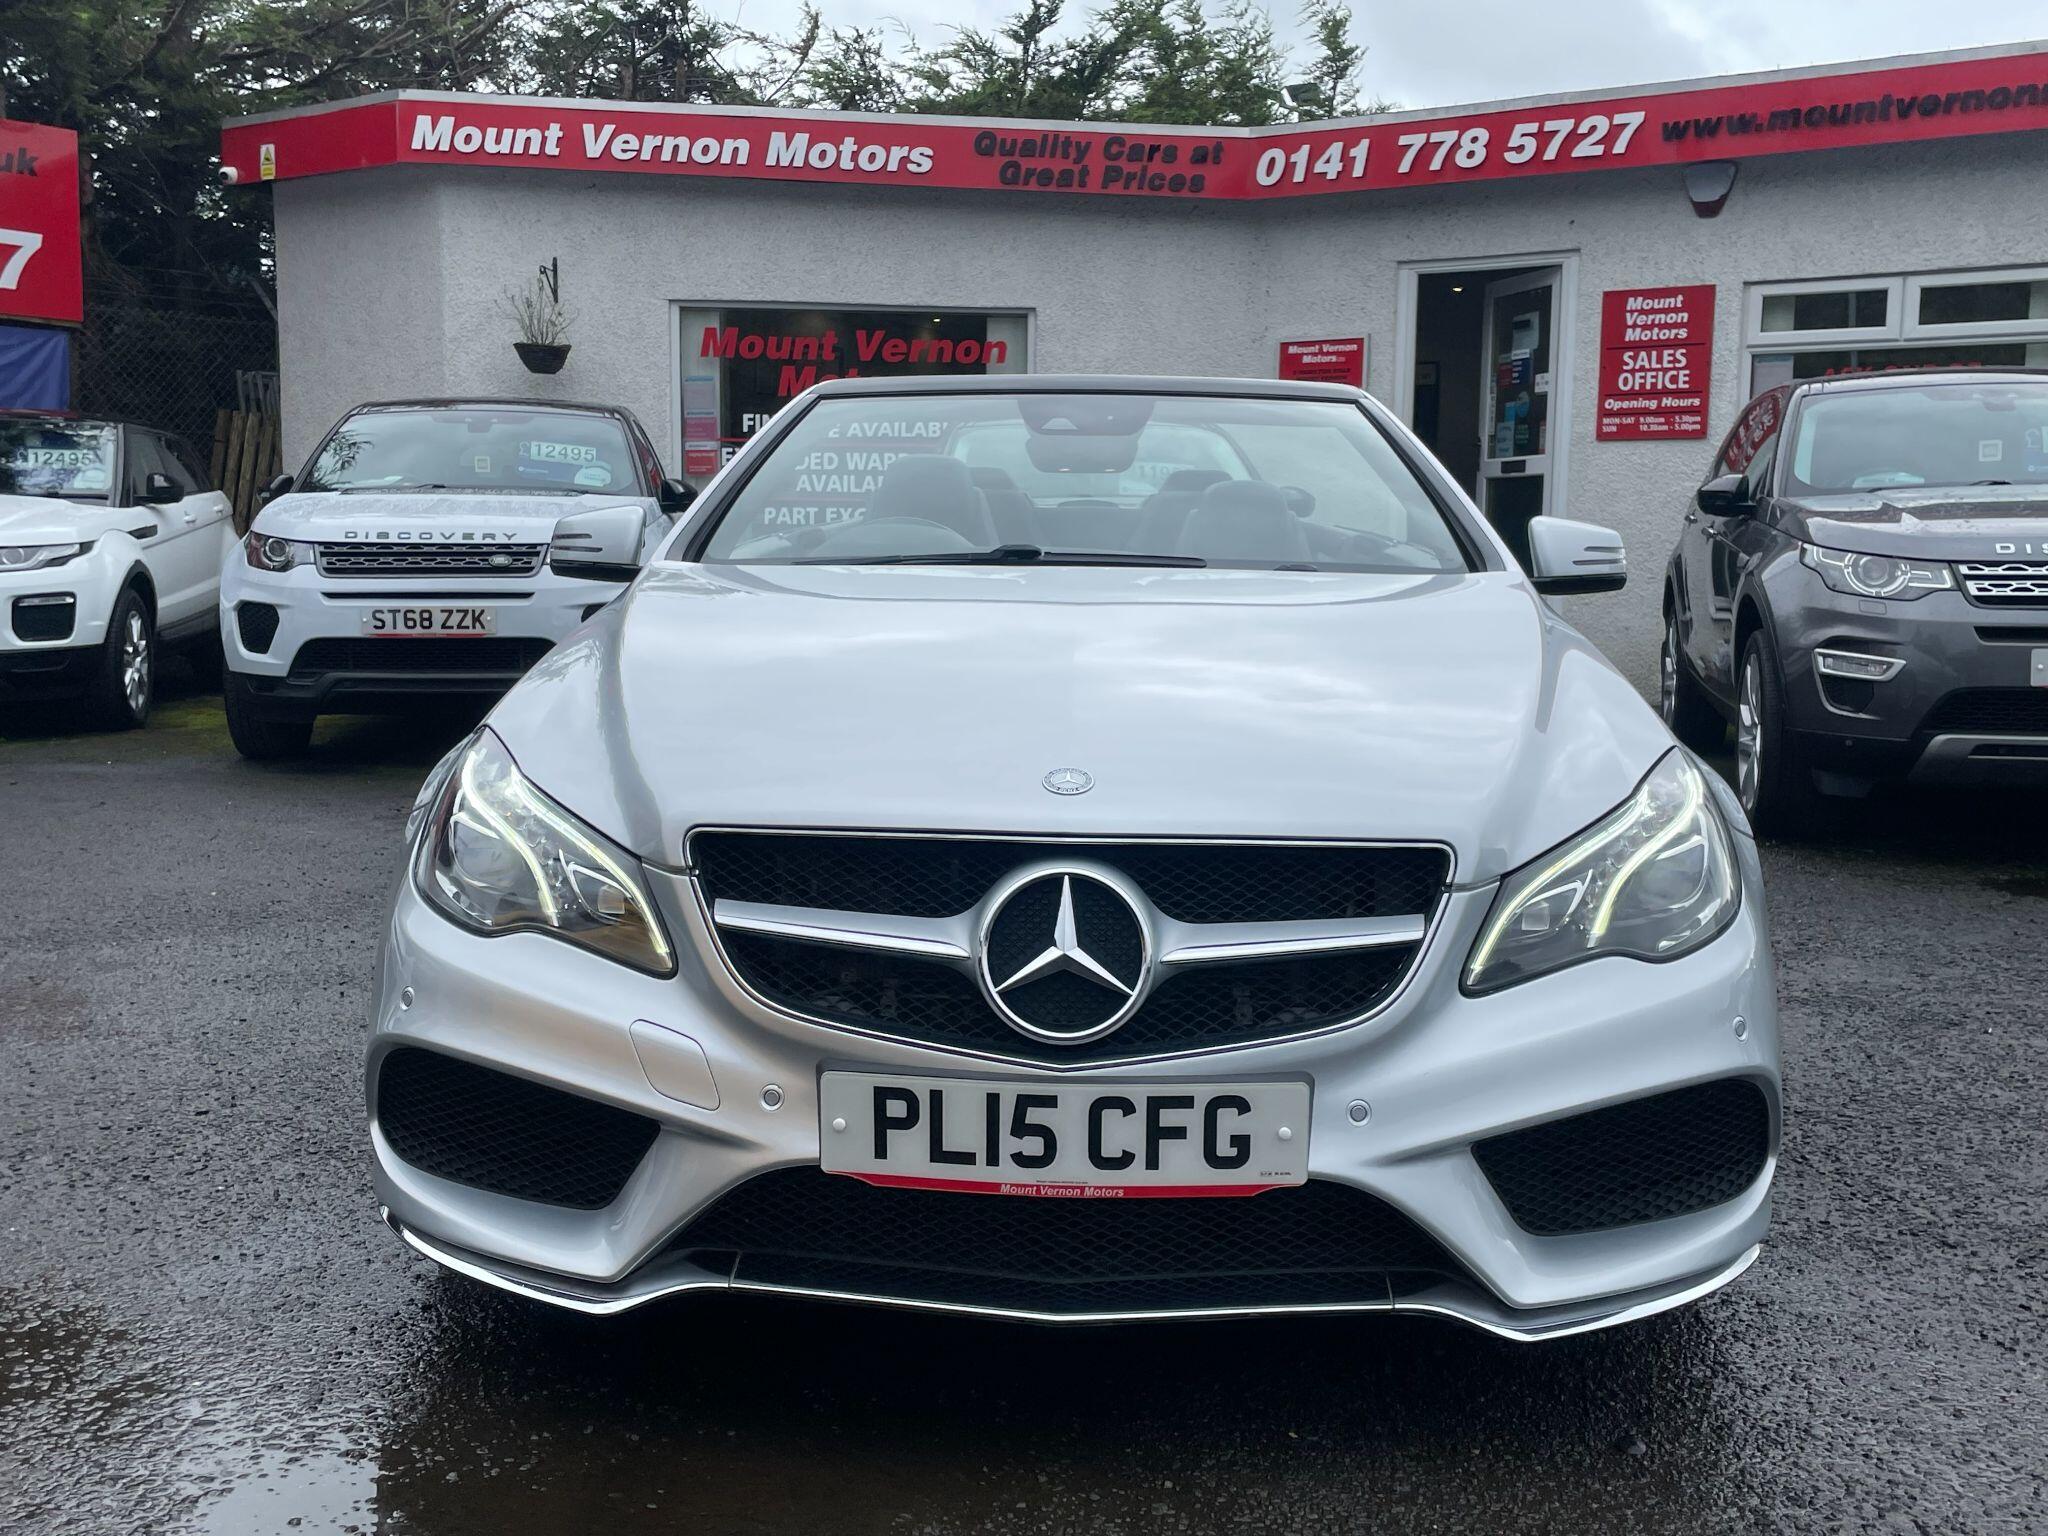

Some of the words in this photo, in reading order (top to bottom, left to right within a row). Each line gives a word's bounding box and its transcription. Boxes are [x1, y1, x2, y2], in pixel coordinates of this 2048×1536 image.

[1661, 82, 2048, 143] www.mountvernon
[411, 114, 563, 157] Mount
[581, 123, 751, 166] Vernon
[765, 131, 935, 174] Motors
[974, 130, 1092, 164] Quality
[1103, 136, 1179, 164] Cars
[1190, 140, 1225, 165] at
[1255, 138, 1371, 187] 0141
[1397, 127, 1490, 174] 778
[1503, 110, 1646, 165] 5727
[999, 160, 1090, 188] Great
[1101, 165, 1205, 193] Prices
[0, 228, 43, 290] 7
[1626, 294, 1684, 311] Mount
[1625, 312, 1689, 326] Vernon
[1624, 327, 1688, 341] Motors
[700, 327, 838, 360] Mount
[856, 329, 1008, 364] Vernon
[1287, 344, 1319, 354] Mount
[1322, 343, 1358, 352] Vernon
[1302, 355, 1337, 364] Motors
[1622, 349, 1687, 370] SALES
[1618, 370, 1690, 391] OFFICE
[1604, 398, 1657, 411] Opening
[1661, 397, 1701, 408] Hours
[1602, 424, 1618, 433] SUN
[764, 507, 819, 525] PART
[344, 530, 518, 541] DISCOVERY
[371, 609, 433, 630] ST68
[440, 609, 487, 630] ZZK
[872, 1085, 1059, 1169] PL15
[1087, 1094, 1252, 1171] CFG
[1000, 1183, 1037, 1194] Mount
[1040, 1185, 1081, 1196] Vernon
[1084, 1187, 1124, 1197] Motors
